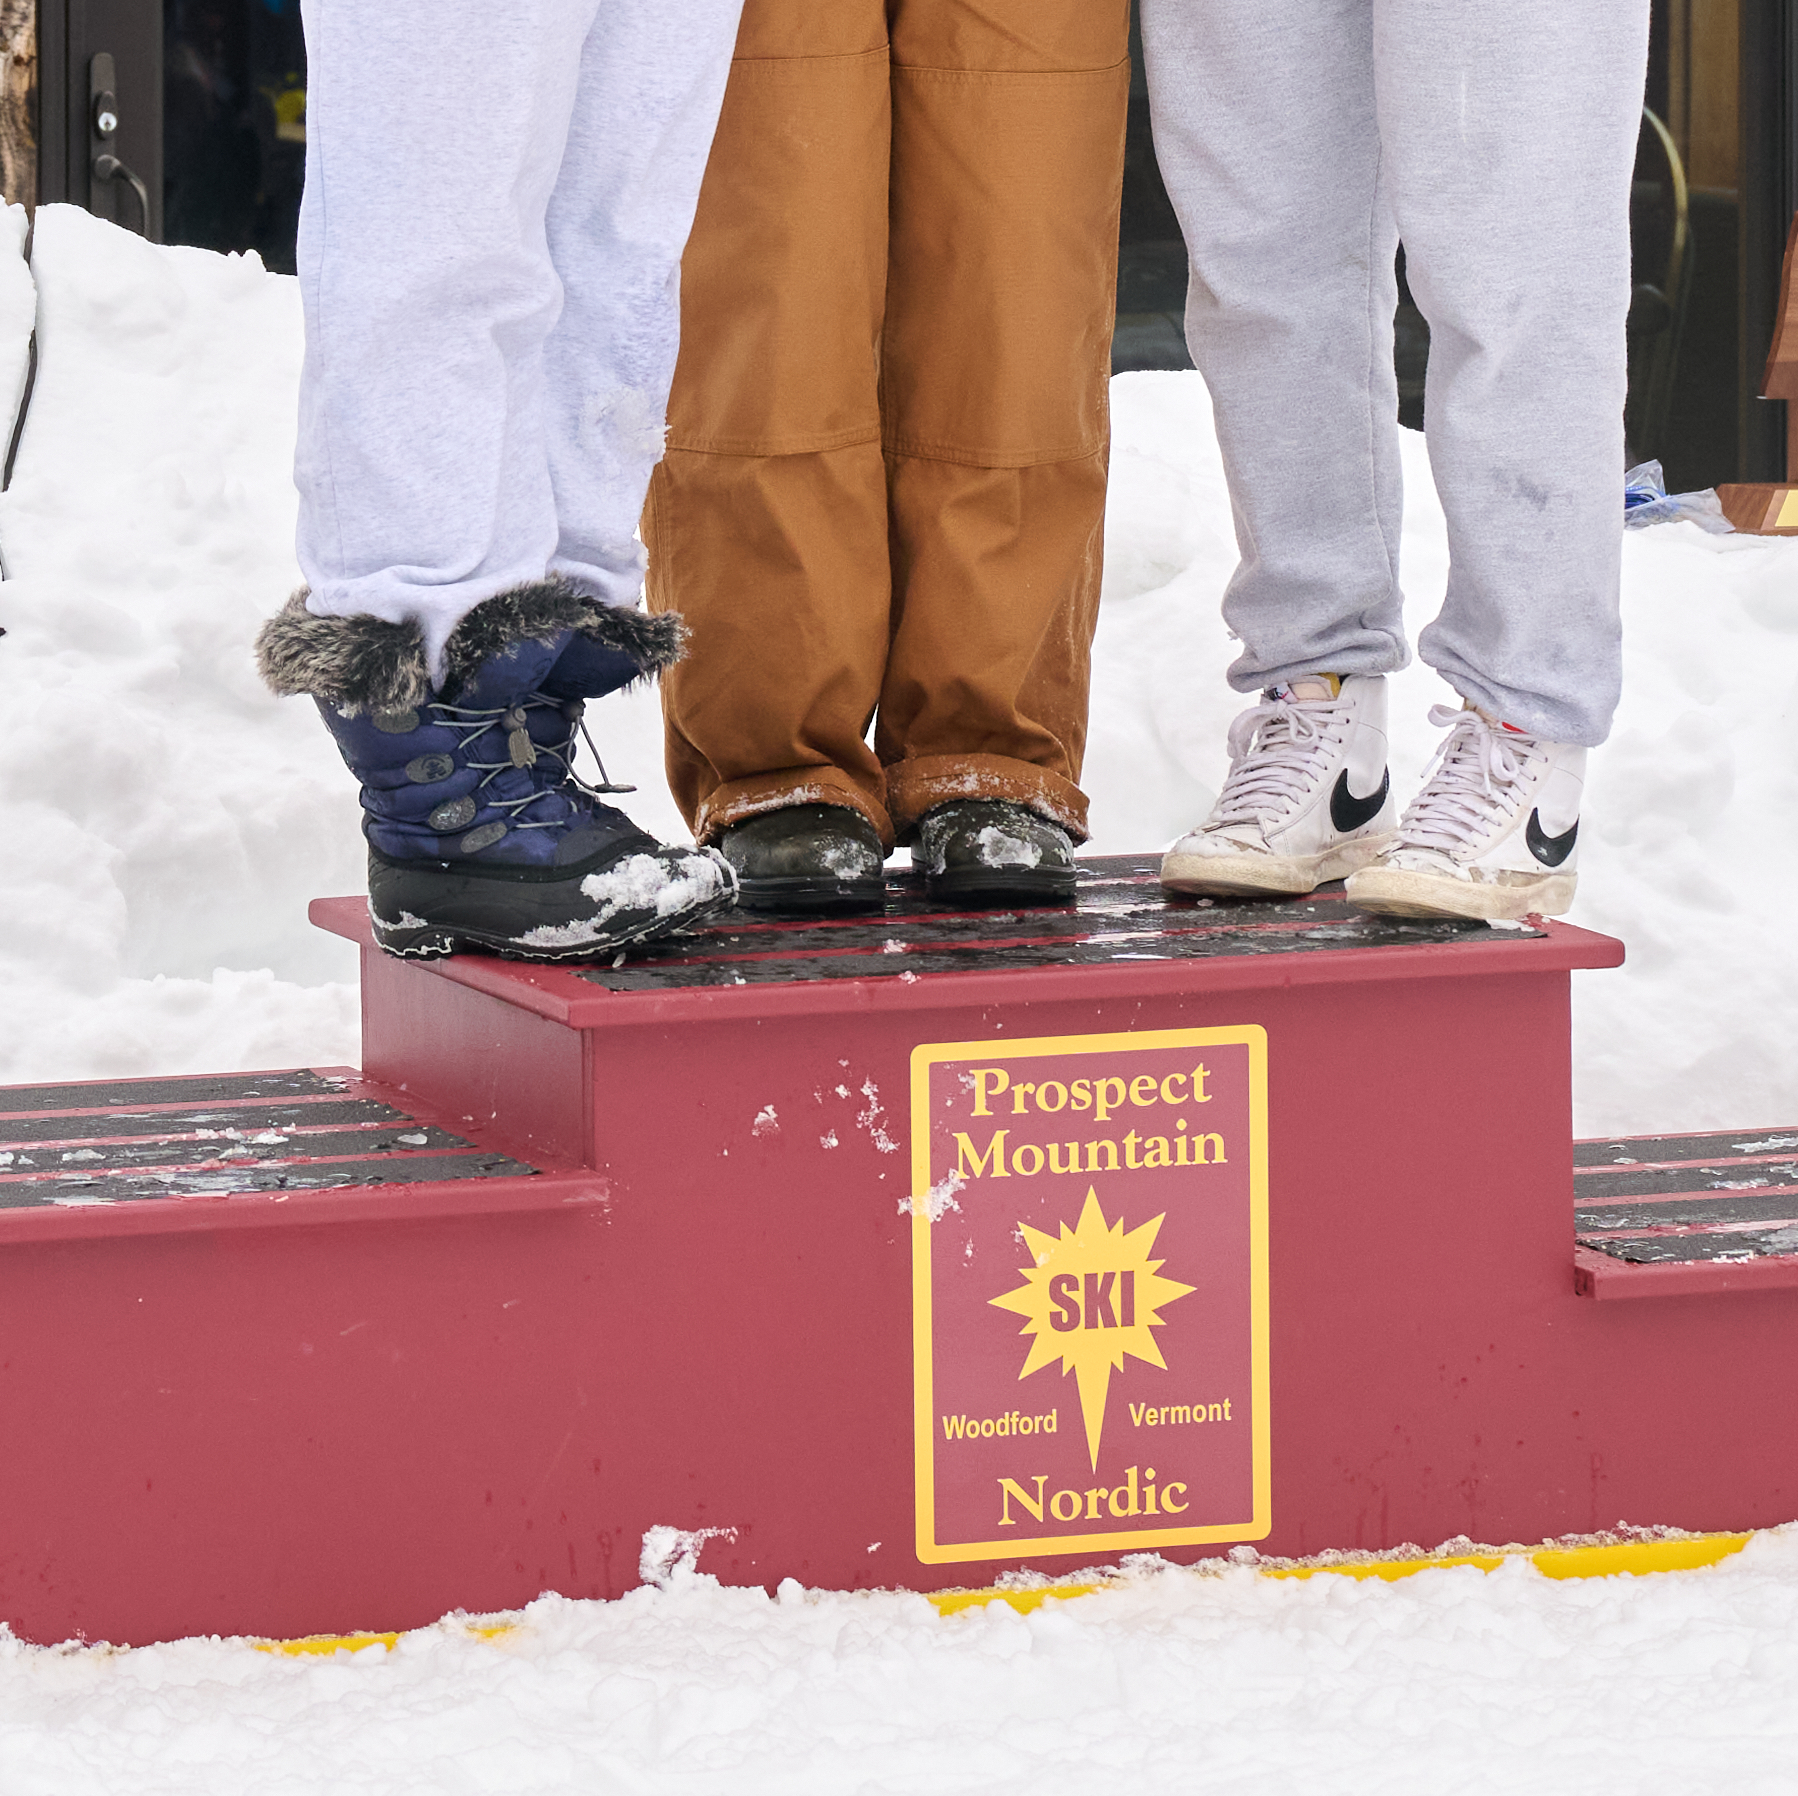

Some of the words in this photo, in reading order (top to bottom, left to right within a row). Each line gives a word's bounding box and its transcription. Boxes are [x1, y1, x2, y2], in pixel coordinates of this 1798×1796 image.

[969, 1062, 1213, 1121] Prospect
[952, 1119, 1228, 1180] Mountain
[1048, 1269, 1136, 1333] SKI
[942, 1408, 1058, 1440] Woodford
[1128, 1397, 1233, 1428] Vermont
[997, 1465, 1190, 1526] Nordic
